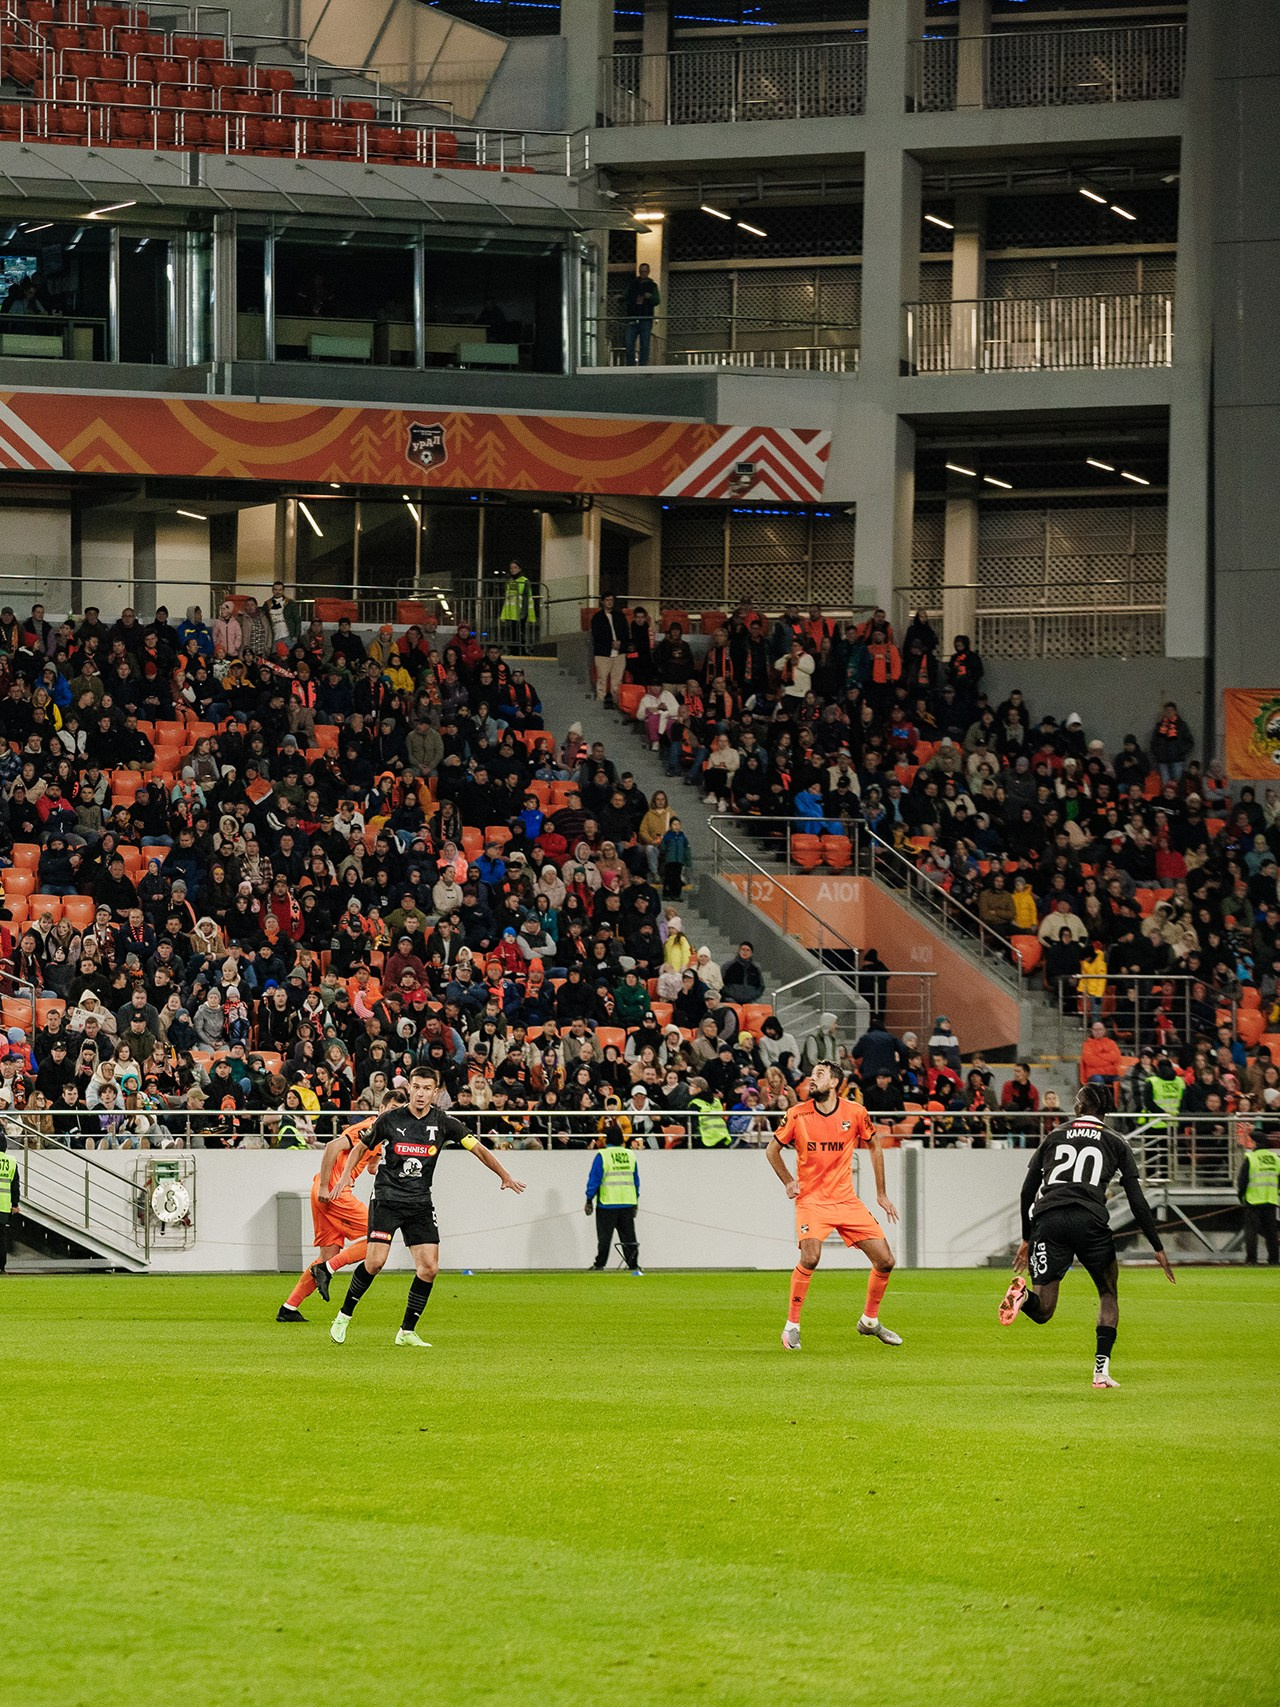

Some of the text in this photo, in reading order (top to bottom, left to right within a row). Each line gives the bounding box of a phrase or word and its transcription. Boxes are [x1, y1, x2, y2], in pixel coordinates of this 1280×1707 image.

[412, 435, 441, 452] УРАЛ
[816, 883, 860, 903] A101
[397, 1144, 427, 1154] TENNISI
[820, 1142, 845, 1151] TMK
[1048, 1144, 1104, 1187] 20
[1036, 1242, 1048, 1275] Cola
